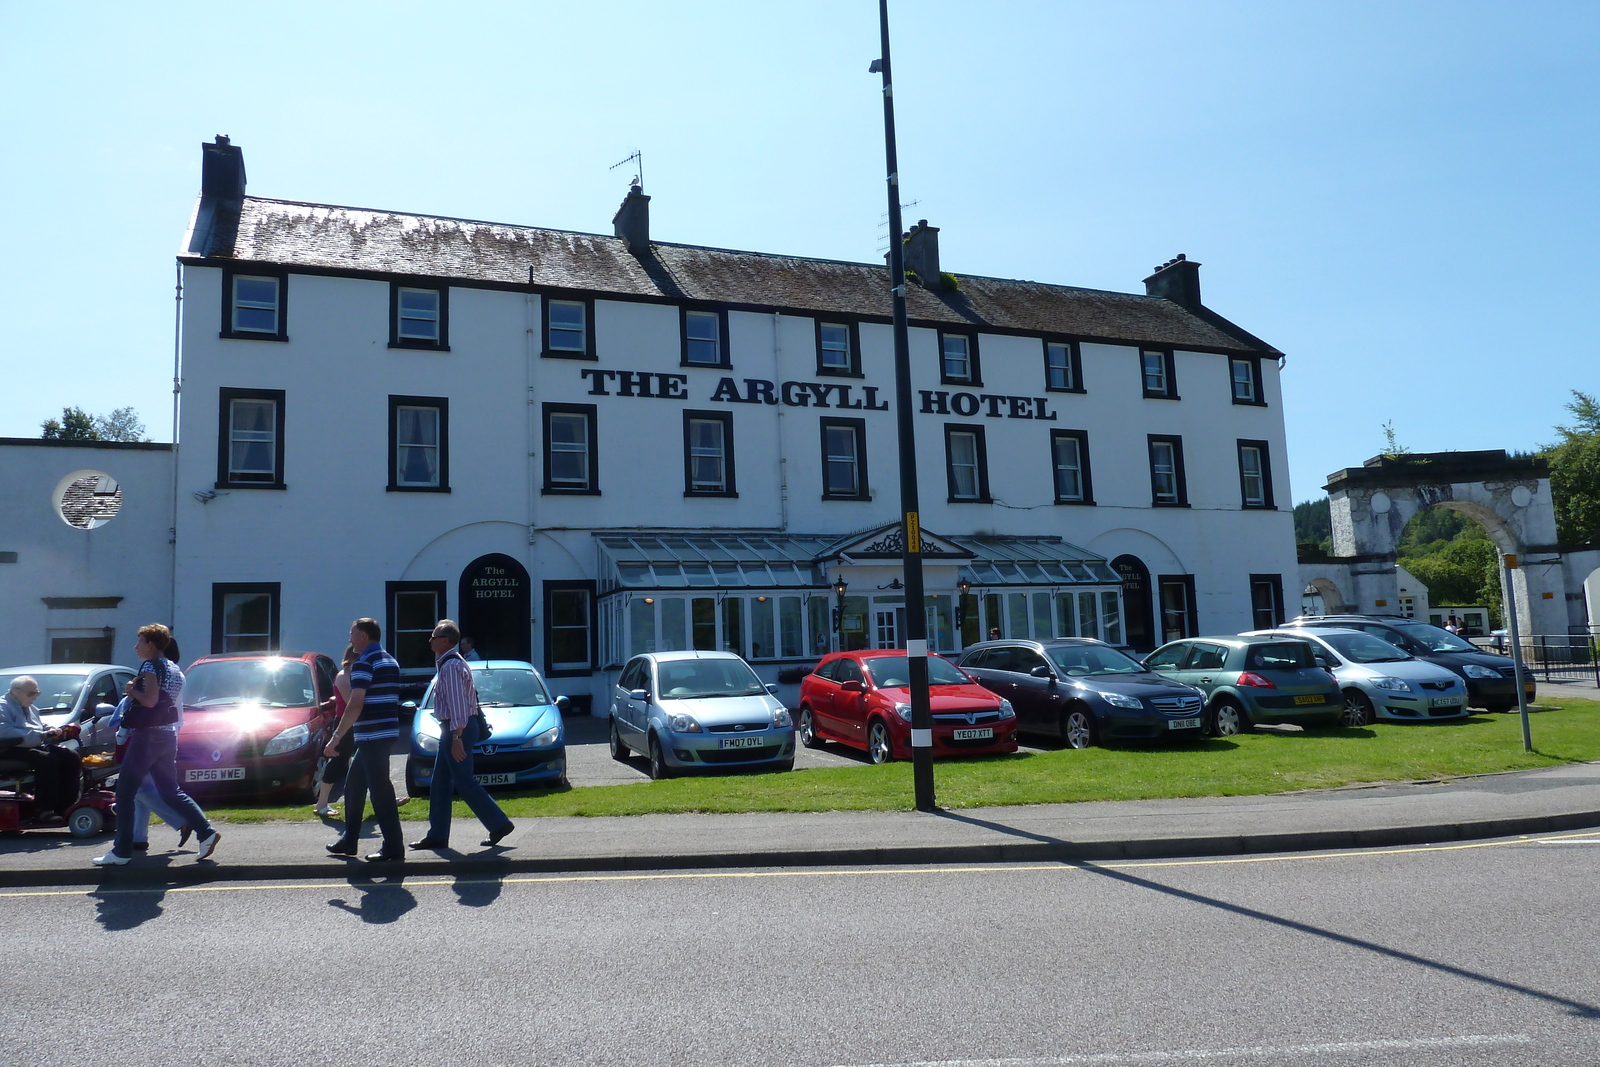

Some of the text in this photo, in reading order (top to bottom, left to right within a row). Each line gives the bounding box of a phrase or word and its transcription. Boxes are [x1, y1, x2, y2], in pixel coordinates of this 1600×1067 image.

[581, 368, 1057, 420] THE ARGYLL HOTEL
[484, 566, 505, 575] The
[471, 578, 519, 587] ARGYLL
[475, 590, 515, 598] HOTEL
[957, 729, 991, 738] YE07 XTT
[724, 737, 762, 747] FM07 OYL
[190, 769, 241, 780] SP56 WWE
[491, 774, 509, 783] HSA
